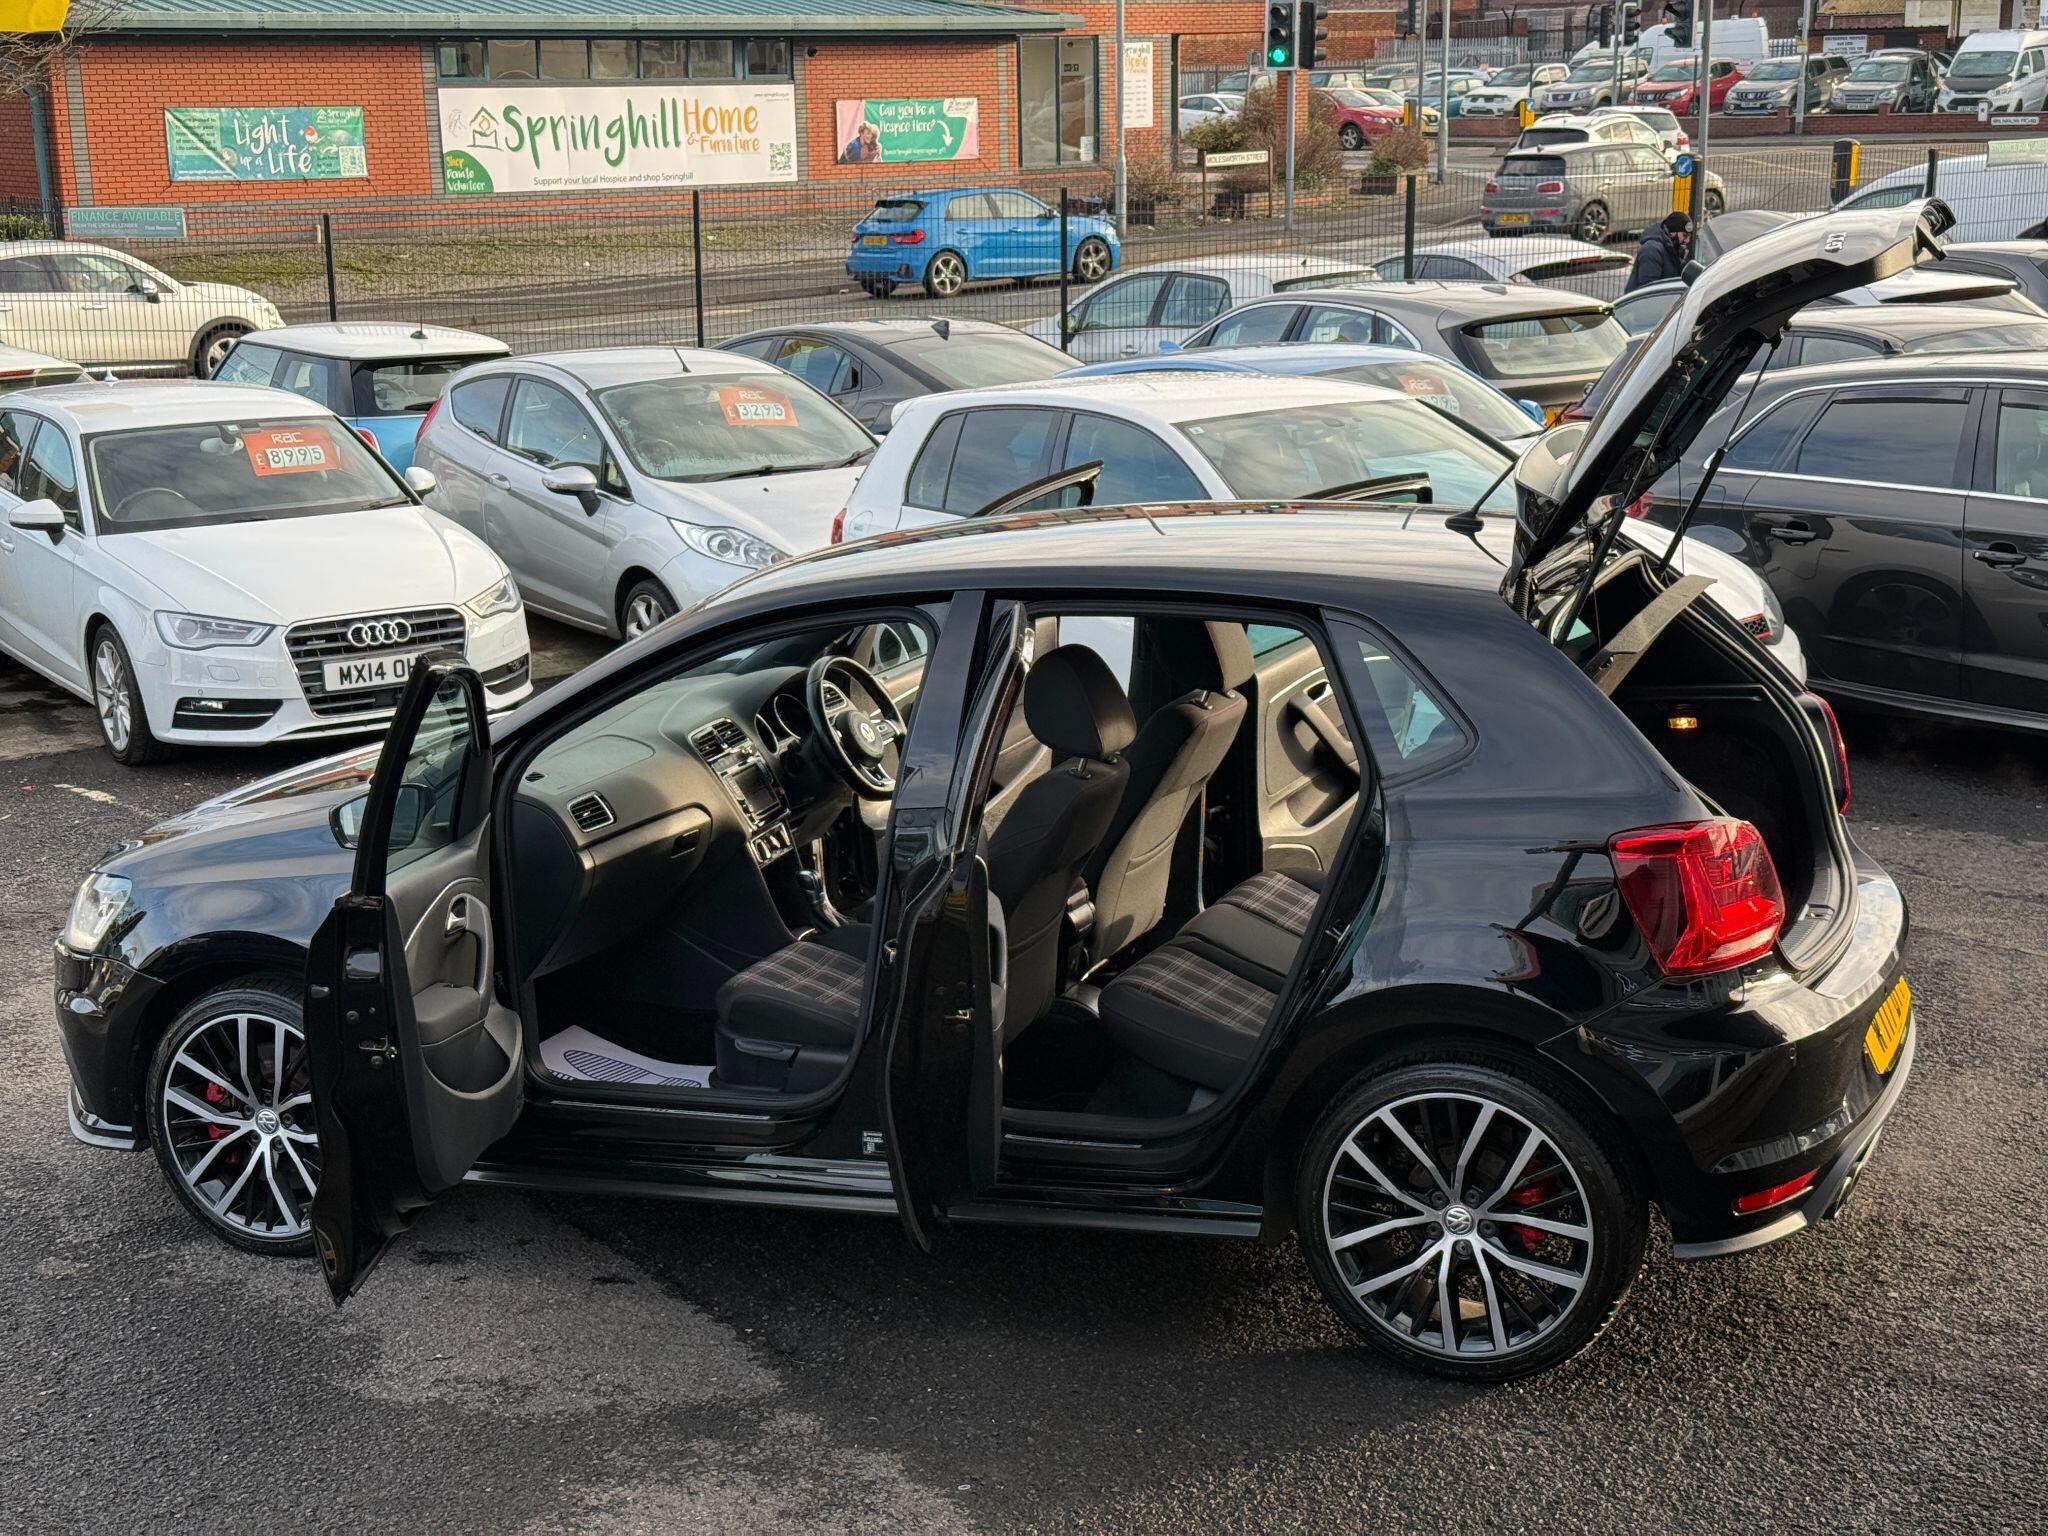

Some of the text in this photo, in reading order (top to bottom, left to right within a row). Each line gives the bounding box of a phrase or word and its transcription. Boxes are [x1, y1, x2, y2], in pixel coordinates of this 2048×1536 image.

[879, 103, 936, 120] Can you be a
[232, 115, 290, 155] Light
[502, 97, 759, 170] Springhill Home
[879, 119, 937, 137] Hospice Hero?
[699, 133, 760, 155] Furniture
[239, 155, 253, 171] up
[254, 155, 264, 167] a
[267, 144, 313, 175] Life
[1206, 153, 1267, 164] MOLESWORTH STREET
[446, 168, 475, 179] Donate
[533, 172, 694, 186] Support your local Hospice and shop Springhill
[447, 180, 486, 192] Volunteer
[71, 211, 181, 222] FINANCE AVAILABLE
[339, 657, 416, 685] MX14 OH
